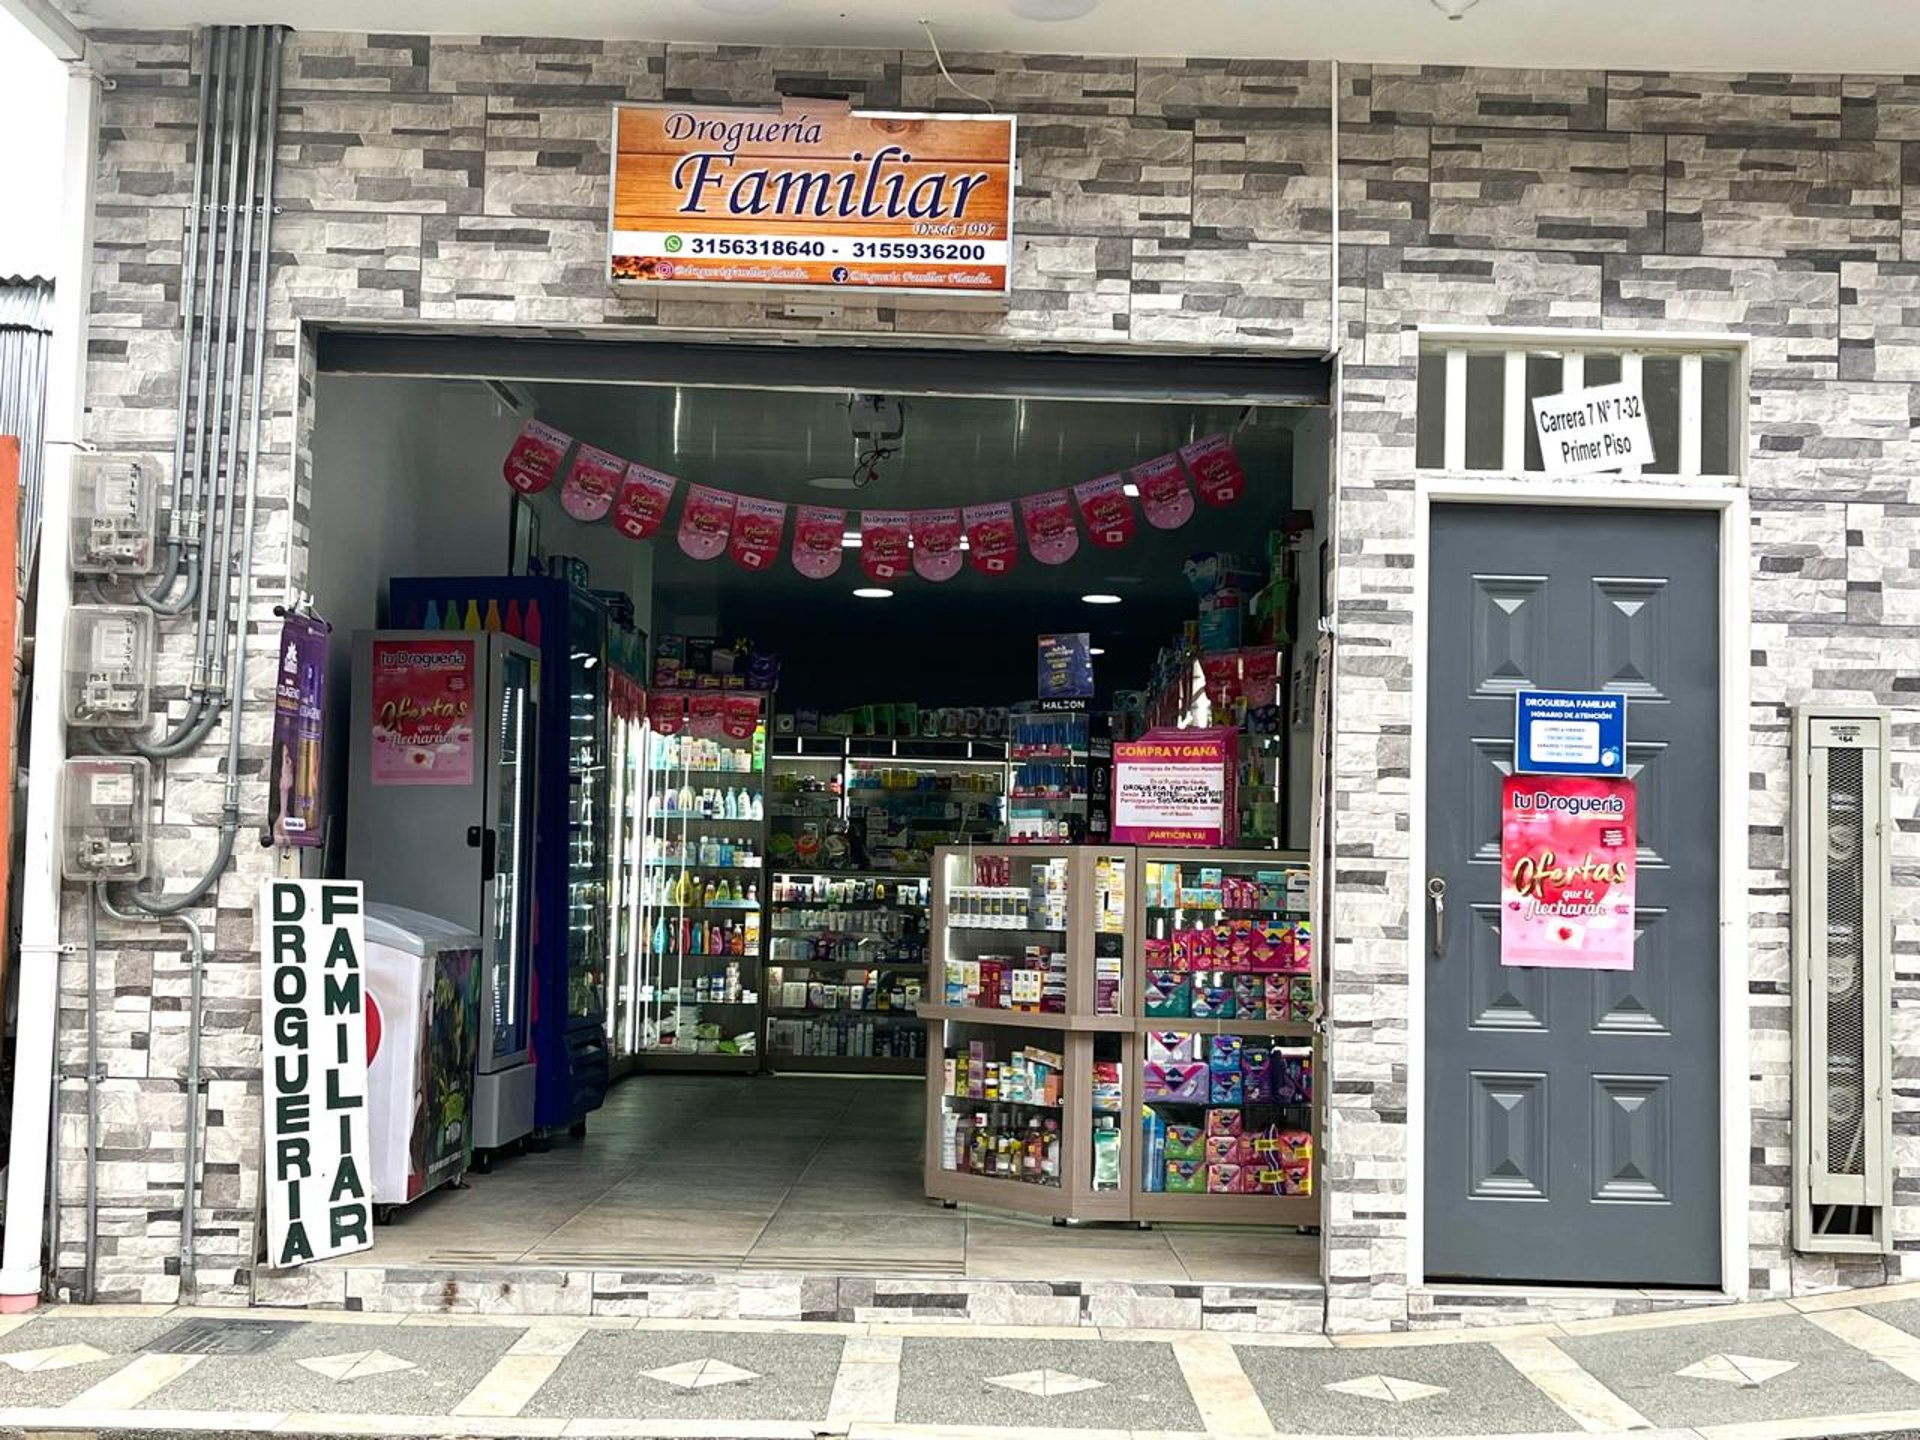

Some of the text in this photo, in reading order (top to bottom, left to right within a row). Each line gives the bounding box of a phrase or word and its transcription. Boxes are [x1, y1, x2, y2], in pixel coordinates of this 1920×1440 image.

[664, 112, 822, 151] Droguería
[674, 145, 988, 219] Familiar
[915, 221, 957, 236] Desde
[691, 238, 824, 257] 3156318640
[852, 242, 985, 261] 3155936200
[1540, 410, 1586, 434] Carrera
[1586, 402, 1594, 425] 7
[1614, 395, 1641, 420] 7-32
[1561, 433, 1632, 464] Primer Piso
[381, 650, 465, 668] tu Droguería
[380, 697, 468, 731] Ofertas
[1041, 700, 1086, 710] HALEON
[1530, 710, 1563, 719] HORARIO
[1577, 700, 1617, 709] FAMILIAR
[417, 724, 432, 733] que
[1116, 746, 1218, 757] COMPRA Y GANA
[1513, 791, 1624, 815] tu Droguería
[1512, 850, 1628, 898] Ofertas
[1562, 888, 1595, 901] que te
[272, 883, 314, 1265] DROGUERIA
[321, 884, 369, 1250] FAMILIAR
